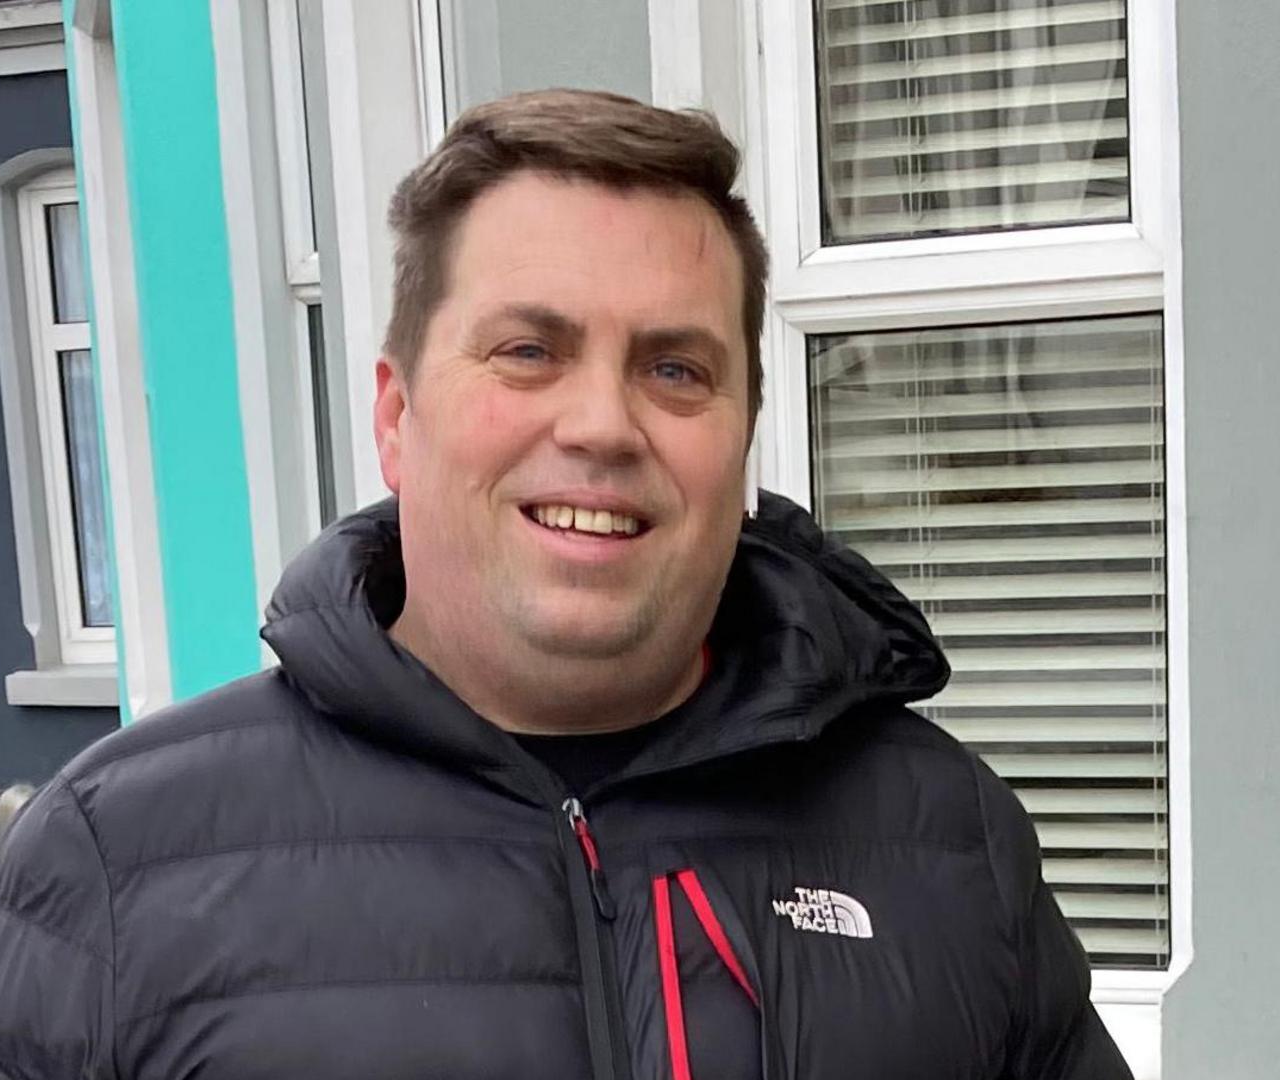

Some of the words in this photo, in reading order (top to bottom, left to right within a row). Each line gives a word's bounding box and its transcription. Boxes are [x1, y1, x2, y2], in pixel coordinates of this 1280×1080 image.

[795, 887, 829, 904] THE
[772, 900, 834, 919] NORTH
[792, 914, 838, 933] FACE
